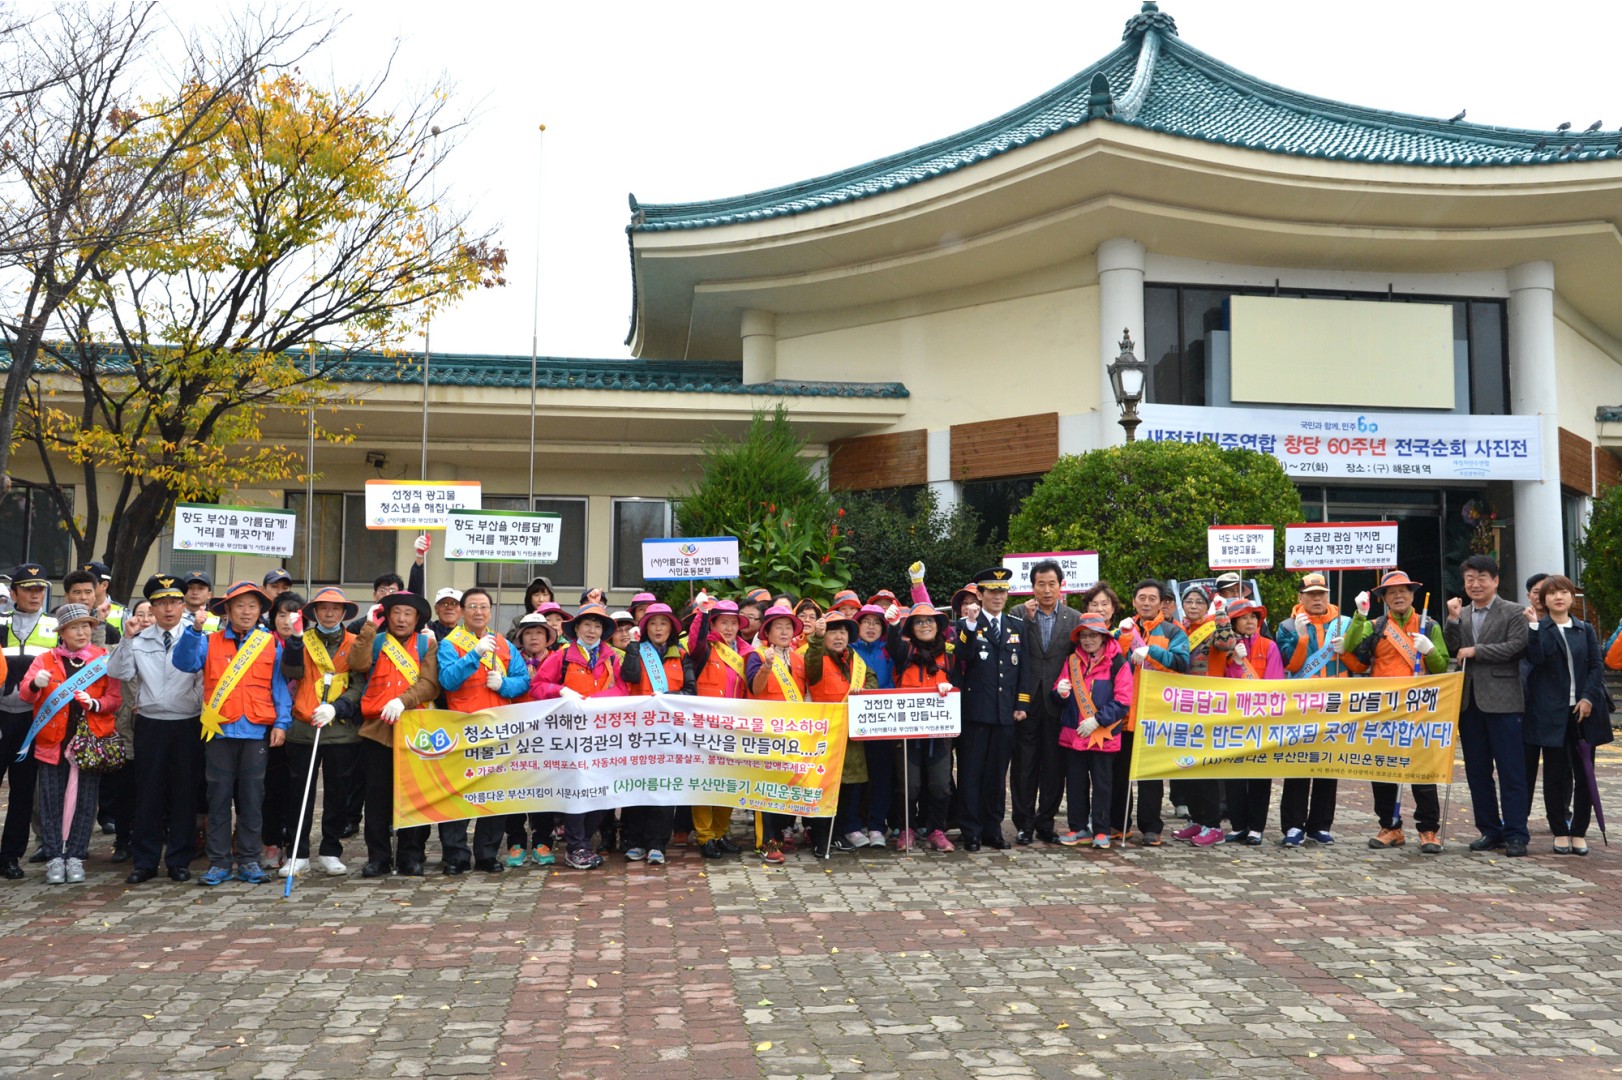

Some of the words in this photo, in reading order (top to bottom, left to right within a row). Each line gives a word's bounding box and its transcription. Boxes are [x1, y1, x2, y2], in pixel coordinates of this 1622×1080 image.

[1300, 420, 1322, 430] 국민과
[1342, 422, 1356, 431] 민주
[1284, 434, 1321, 455] 창당
[1327, 437, 1386, 456] 60주년
[1394, 438, 1467, 458] 전국순회
[1474, 438, 1528, 458] 사진전
[1299, 462, 1329, 473] 27(화)
[1346, 463, 1366, 473] 장소
[1373, 463, 1390, 474] (구)
[391, 490, 422, 501] 선정적
[426, 490, 456, 501] 광고물
[380, 502, 421, 514] 청소년을
[207, 514, 238, 526] 부산을
[242, 516, 288, 529] 아름답게!
[478, 520, 507, 532] 부산을
[511, 521, 554, 533] 아름답게!
[194, 526, 225, 538] 거리를
[229, 528, 275, 541] 깨끗하게!
[465, 533, 495, 546] 거리를
[499, 534, 541, 546] 깨끗하게!
[1218, 534, 1231, 543] 너도
[1232, 534, 1245, 543] 나도
[1304, 532, 1331, 543] 조금만
[1333, 531, 1351, 542] 관심
[1354, 531, 1381, 541] 가지면
[1288, 544, 1323, 556] 우리부산
[1326, 544, 1353, 555] 깨끗한
[1355, 544, 1373, 554] 부산
[1375, 543, 1396, 554] 된다!
[650, 557, 690, 568] (사)아름다운
[692, 556, 729, 566] 부산만들기
[1061, 560, 1077, 569] 없는
[668, 567, 711, 577] 시민운동본부
[863, 699, 893, 710] 건전한
[896, 697, 945, 710] 광고문화는
[1163, 687, 1228, 714] 아름답고
[1236, 691, 1286, 717] 깨끗한
[1293, 691, 1341, 714] 거리를
[1348, 691, 1399, 713] 만들기
[1405, 687, 1439, 712] 위해
[910, 710, 953, 722] 만듭니다.
[464, 720, 541, 744] 청소년에게
[544, 713, 588, 732] 위해한
[593, 711, 636, 729] 선정적
[771, 718, 828, 735] 일소하여
[1140, 719, 1205, 748] 게시물은
[1212, 724, 1263, 749] 반드시
[1268, 723, 1319, 748] 지정된
[1322, 720, 1358, 744] 곳에
[1362, 720, 1453, 748] 부착합시다!
[464, 742, 510, 761] 머물고
[516, 736, 545, 754] 싶은
[549, 733, 623, 753] 도시경관의
[628, 731, 687, 749] 항구도시
[691, 733, 737, 753] 부산을
[509, 760, 541, 772] 전봇대,
[543, 758, 589, 771] 외벽포스터,
[591, 756, 627, 769] 자동차에
[1202, 752, 1268, 767] (사)아름다운
[1272, 751, 1332, 764] 부산만들기
[1337, 752, 1411, 769] 시민운동본부
[507, 787, 553, 800] 부산지킴이
[613, 776, 684, 794] (사)아름다운
[688, 777, 750, 794] 부산만들기
[754, 781, 823, 803] 시민운동본부
